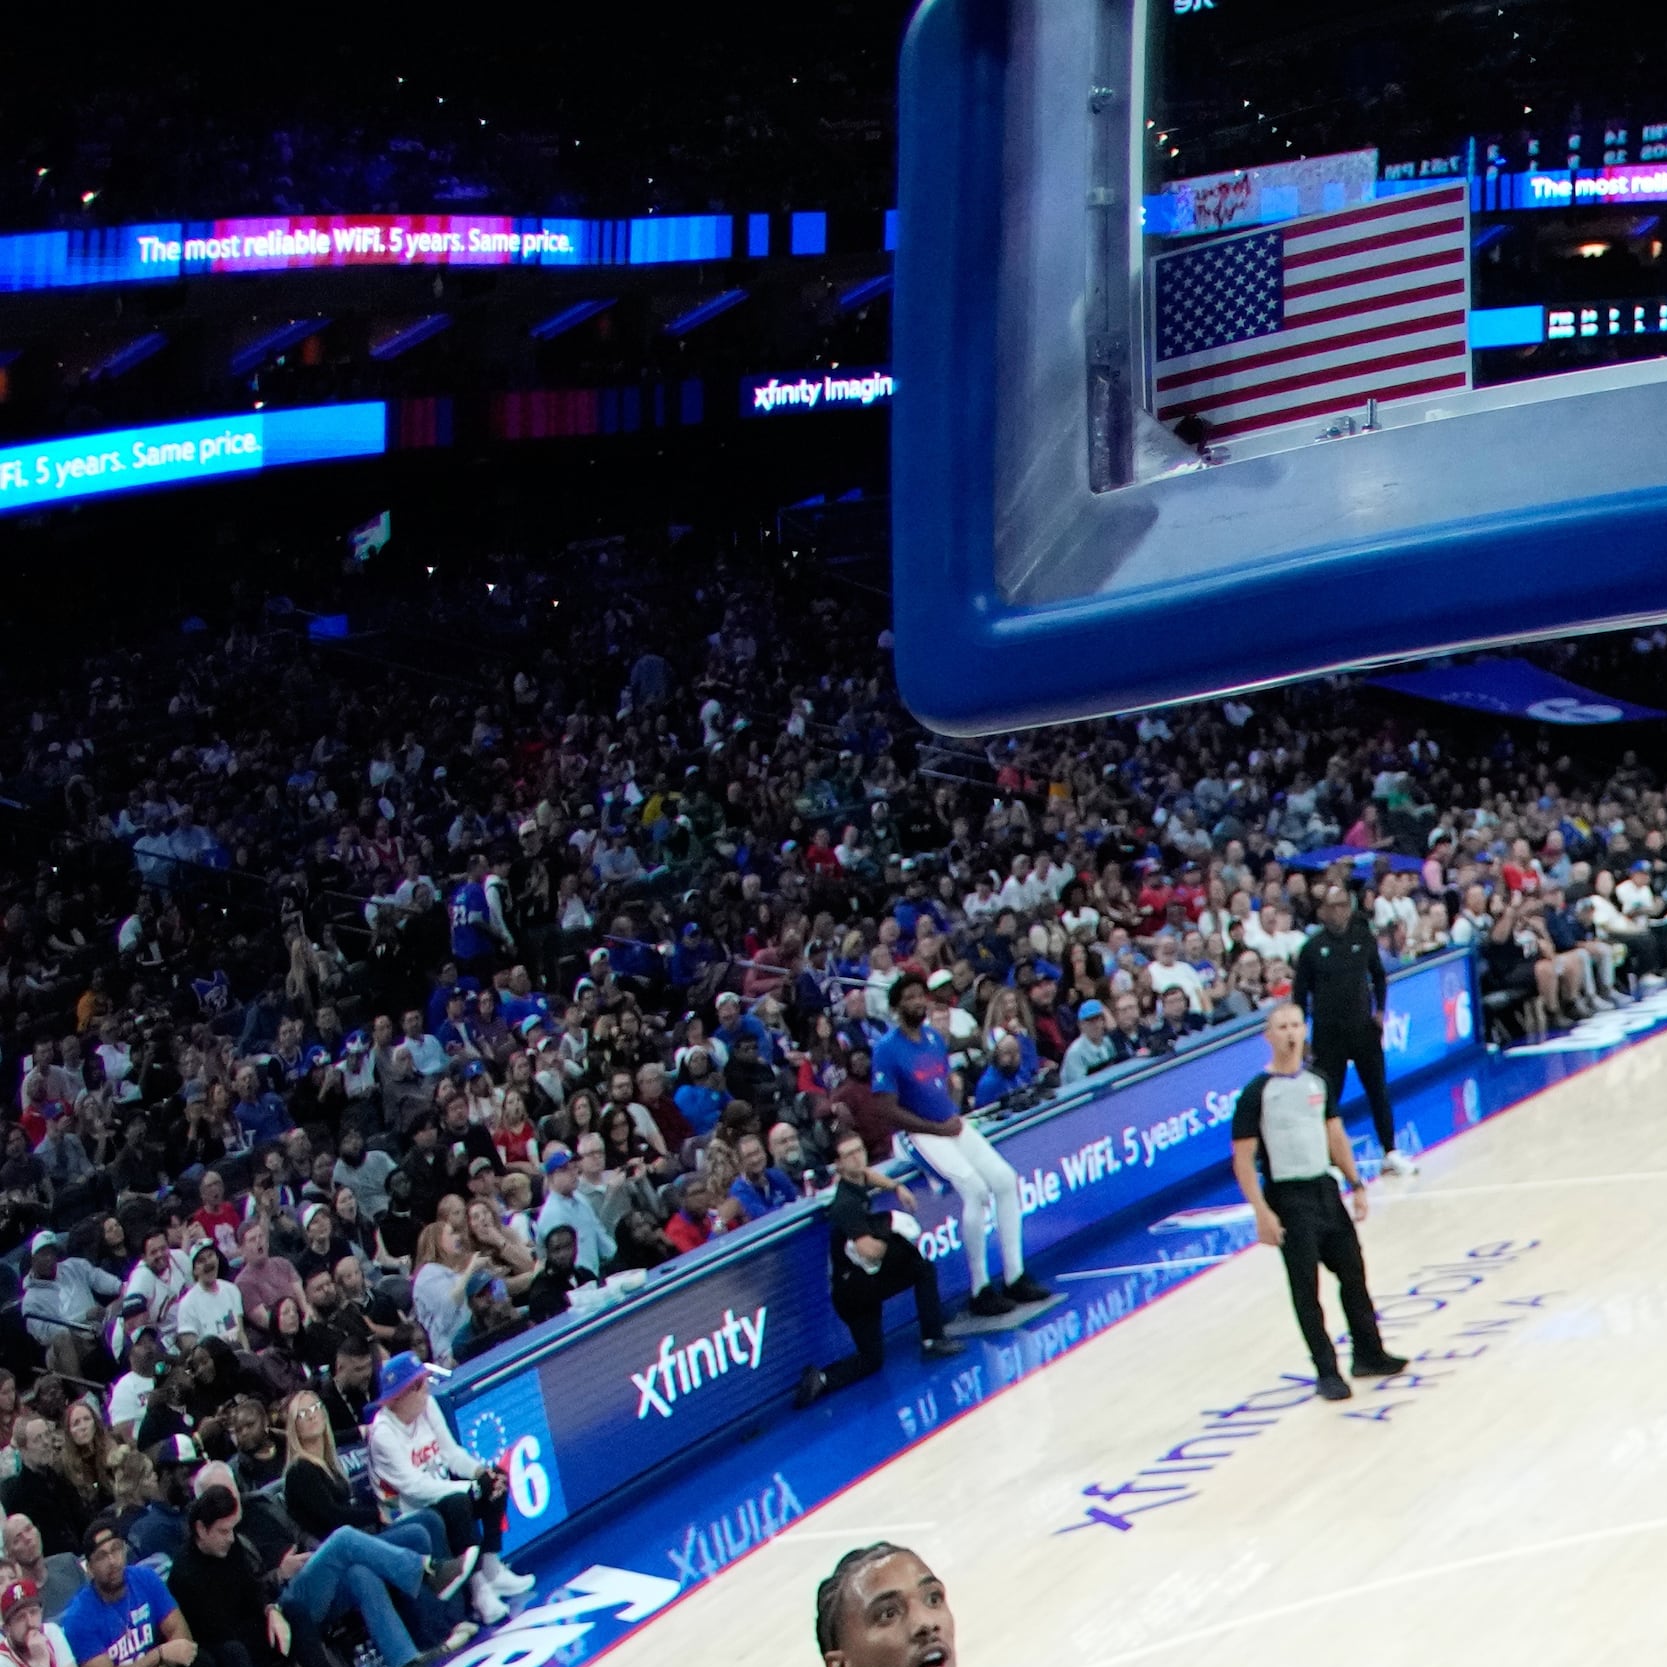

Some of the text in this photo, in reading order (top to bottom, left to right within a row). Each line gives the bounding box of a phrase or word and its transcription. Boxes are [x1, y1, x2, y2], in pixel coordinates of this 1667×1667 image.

[138, 235, 181, 263] The
[184, 234, 240, 261] most
[243, 229, 330, 257] reliable
[389, 226, 403, 252] 5
[468, 228, 521, 252] Same
[824, 371, 894, 405] Imagin
[35, 455, 49, 485] 5
[132, 441, 197, 469] Same
[1061, 1135, 1122, 1192] WiFi.
[1122, 1125, 1140, 1165] 5
[1141, 1106, 1206, 1168] years.
[917, 1215, 962, 1262] ost
[631, 1306, 768, 1420] xfinity
